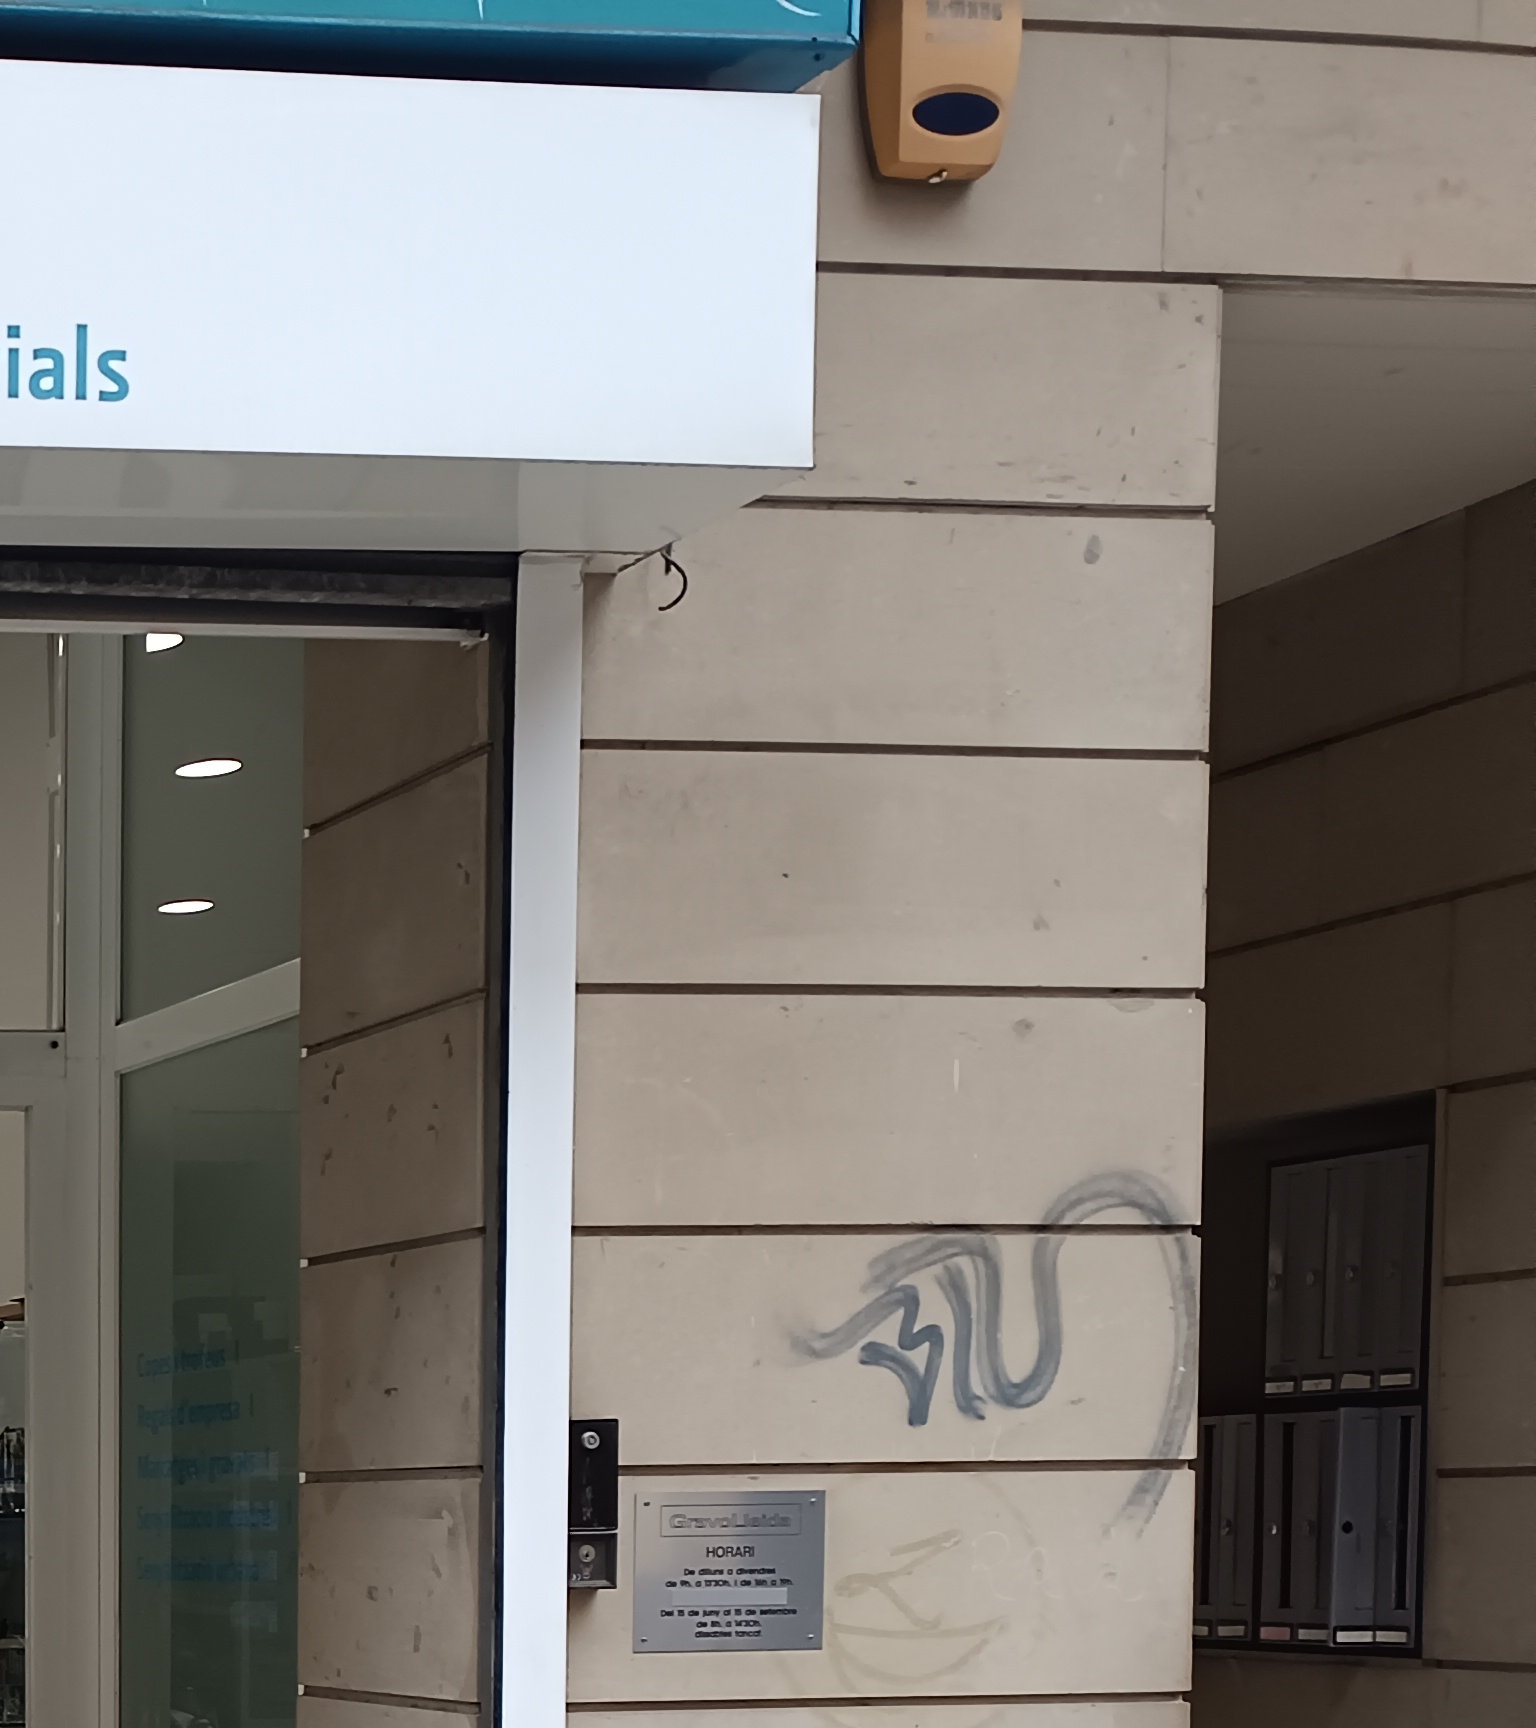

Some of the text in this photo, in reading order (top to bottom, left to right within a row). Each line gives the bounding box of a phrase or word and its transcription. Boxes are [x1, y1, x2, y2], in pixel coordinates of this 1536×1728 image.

[705, 1545, 756, 1559] HORARI
[683, 1568, 696, 1576] De
[698, 1568, 725, 1576] dilluns
[736, 1567, 777, 1575] divendres
[665, 1580, 678, 1588] de
[740, 1579, 752, 1587] de
[687, 1609, 700, 1617] de
[744, 1608, 757, 1616] de
[759, 1608, 798, 1616] setembre
[696, 1621, 708, 1629] de
